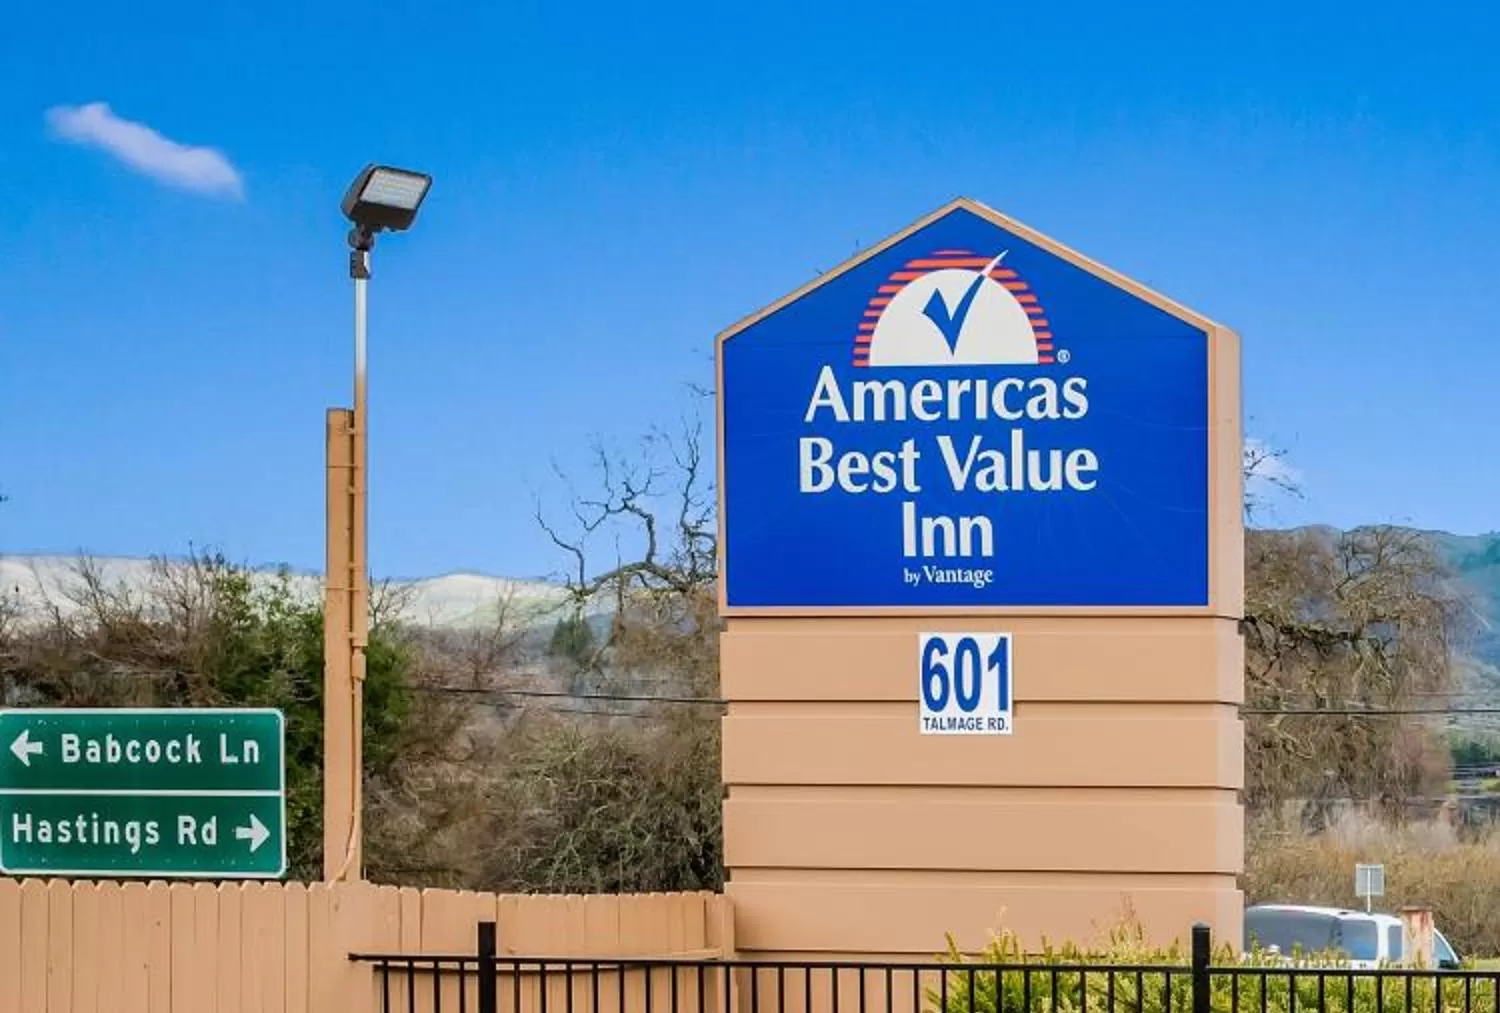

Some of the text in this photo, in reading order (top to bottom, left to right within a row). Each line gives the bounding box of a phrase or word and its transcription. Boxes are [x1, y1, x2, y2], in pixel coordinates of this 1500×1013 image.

[805, 364, 1089, 422] Americas
[799, 429, 1098, 493] Best Value
[902, 501, 993, 557] Inn
[903, 565, 993, 589] by Vantage
[922, 636, 1009, 712] 601
[61, 733, 260, 764] Babcock Ln
[923, 717, 1009, 731] TALMAGE RD.
[12, 812, 217, 855] Hastings Rd
